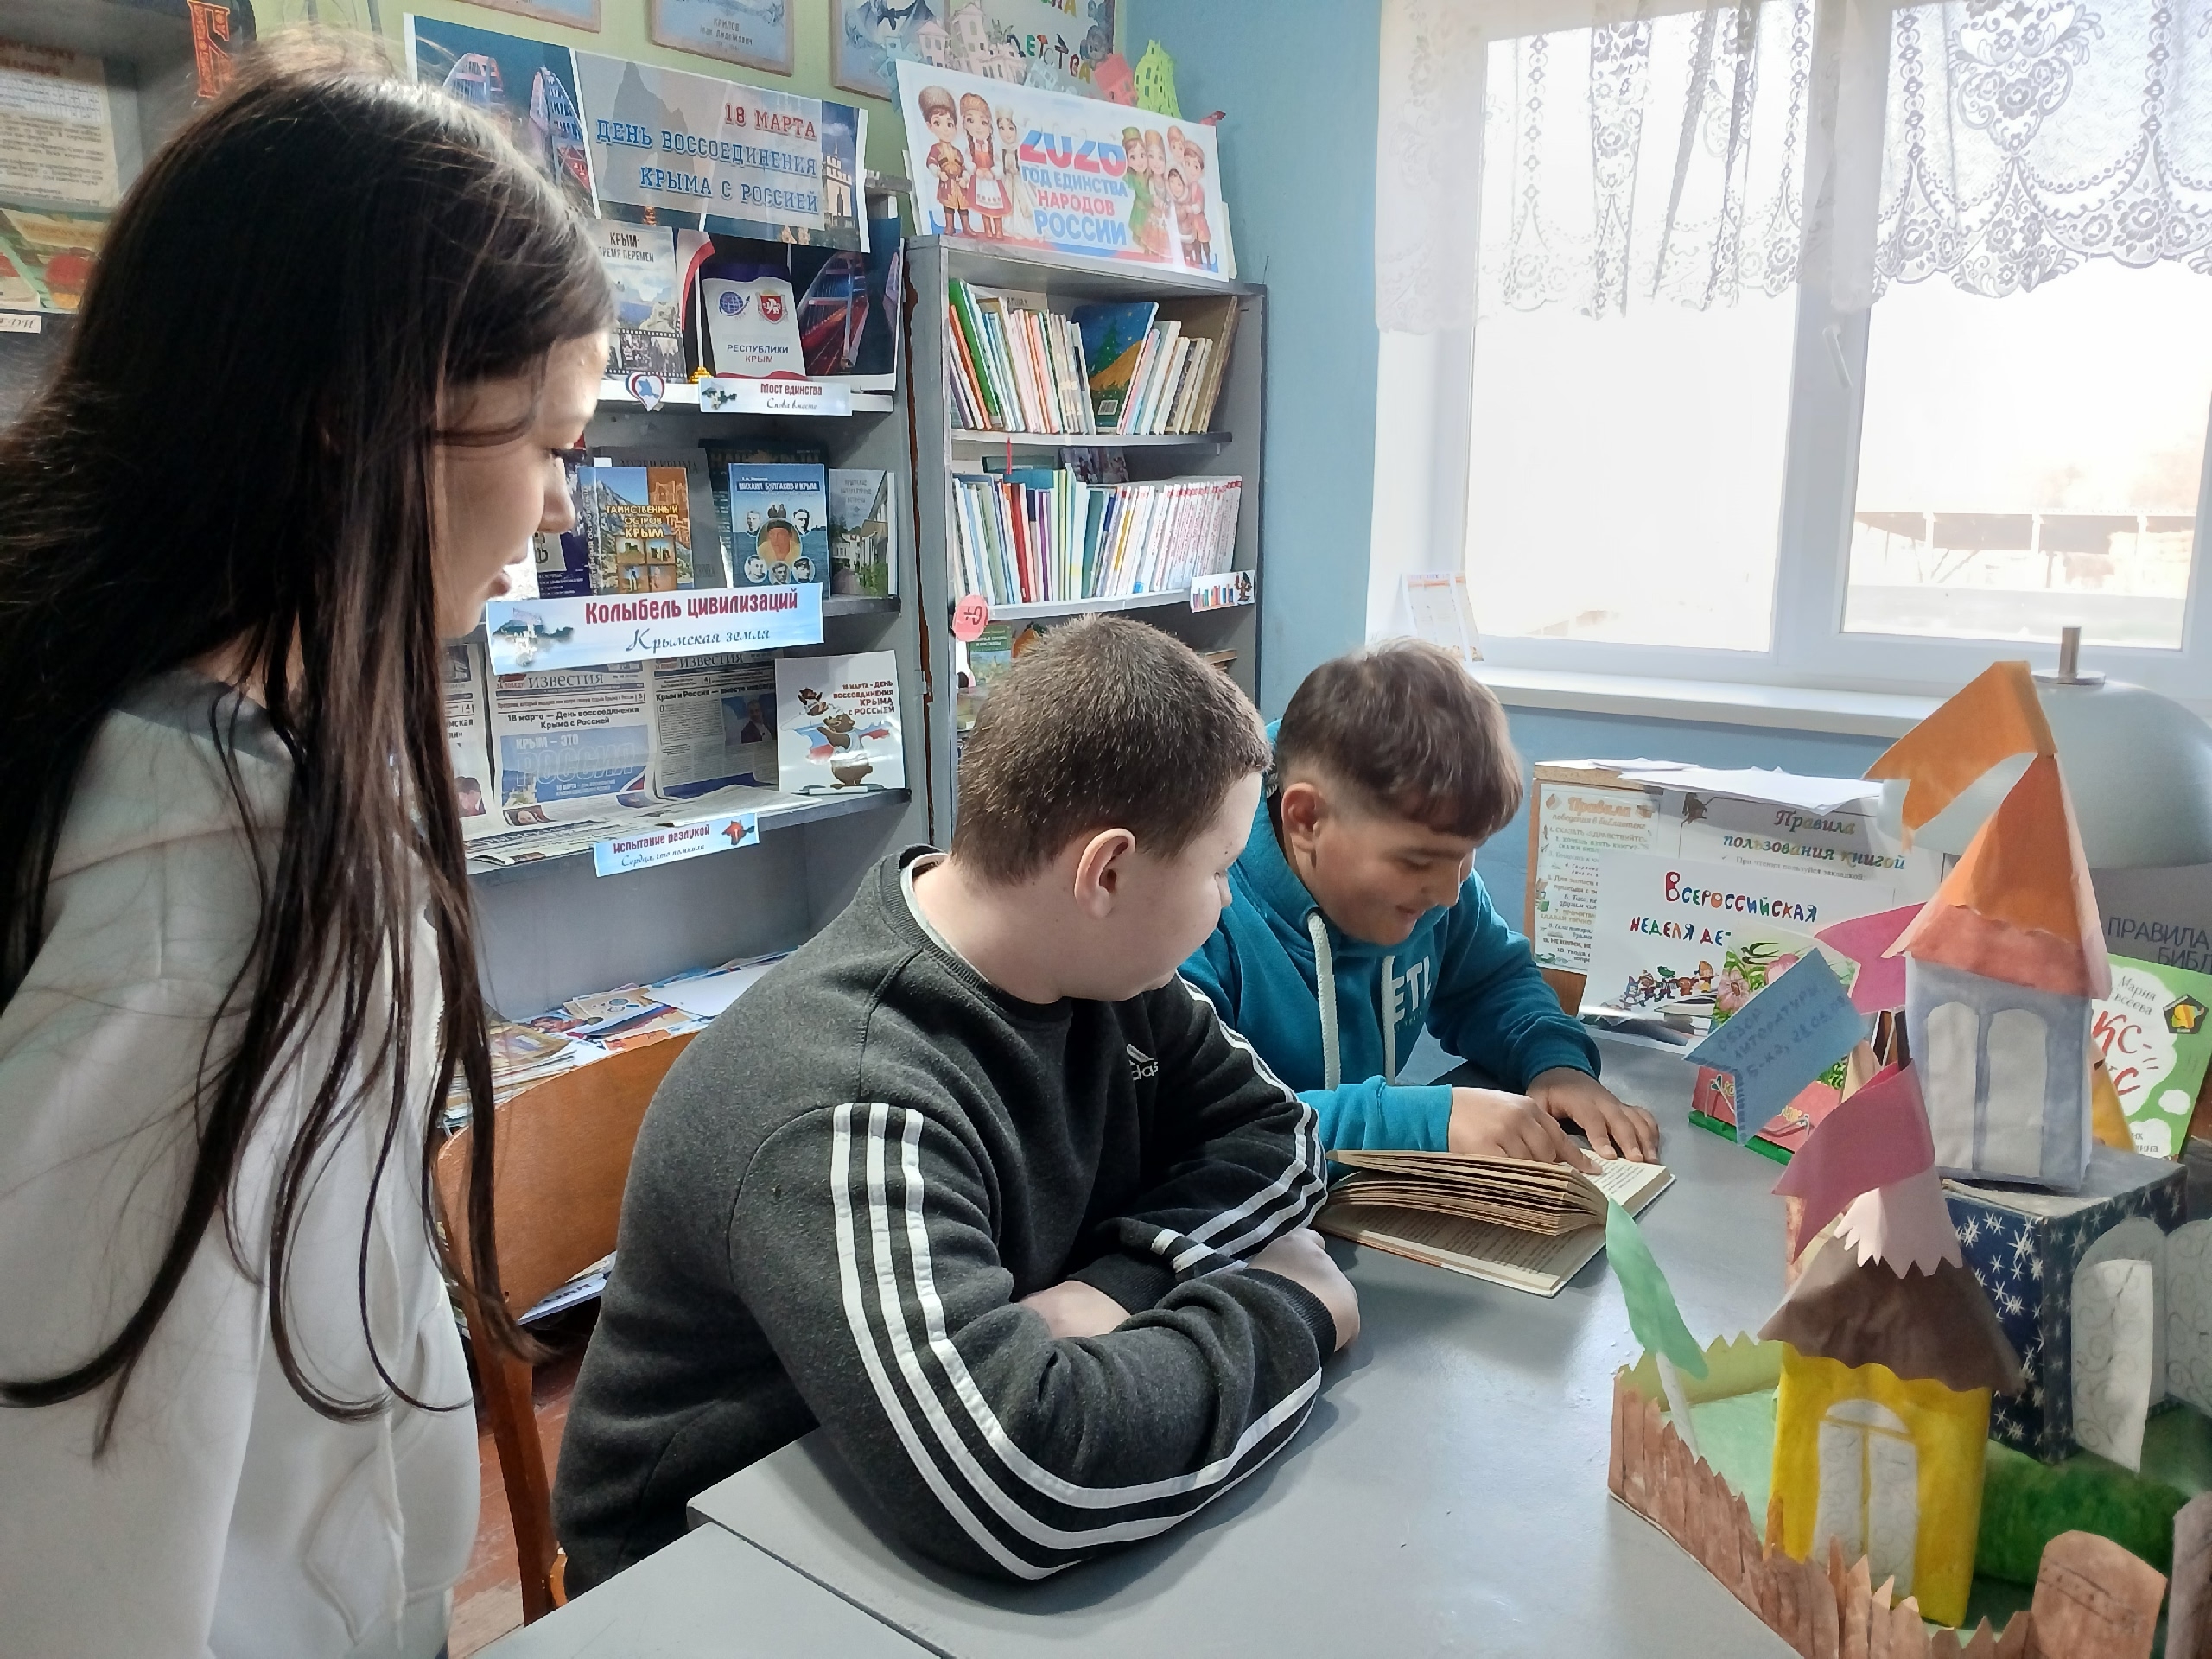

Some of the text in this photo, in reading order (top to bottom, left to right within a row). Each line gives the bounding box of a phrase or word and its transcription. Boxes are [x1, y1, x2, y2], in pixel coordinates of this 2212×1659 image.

[725, 102, 817, 139] 18 МАРТА
[596, 119, 818, 176] ДЕНЬ ВОССОЕДИНЕНИЯ
[640, 167, 713, 197] КРЫМА
[741, 183, 819, 213] РОССИЕЙ
[1021, 165, 1128, 197] ГОД ЕДИНСТВА
[1037, 190, 1116, 216] НАРОДОВ
[609, 232, 640, 248] КРЫМ:
[1034, 209, 1127, 245] РОССИИ
[623, 250, 655, 263] ПЕРЕМЕН
[727, 344, 789, 353] РЕСПУБЛИКИ
[785, 385, 823, 396] единства
[606, 504, 678, 514] ТАИНСТВЕННЫЙ
[624, 516, 663, 525] ОСТРОВ
[625, 527, 664, 538] КРЫМ
[585, 588, 798, 624] Колыбель цивилизаций
[625, 628, 771, 654] Крымская земля
[656, 693, 677, 702] Крым
[874, 680, 893, 689] ДЕНЬ
[860, 697, 893, 706] КРЫМА
[518, 713, 544, 723] марта
[556, 711, 577, 721] День
[516, 736, 548, 750] КРЫМ
[560, 734, 579, 746] ЭТО
[516, 743, 636, 787] РОССИЯ
[1773, 810, 1855, 835] Правила
[613, 824, 710, 854] Испытание разлукой
[1723, 835, 1905, 870] пользования книгой
[1736, 855, 1752, 865] При
[1630, 916, 1732, 947] НЕДЕЛЯ ДЕ
[2108, 917, 2209, 950] ПРАВИЛА
[2158, 946, 2212, 975] БИБЛ
[2118, 975, 2157, 1001] Мария
[2110, 987, 2152, 1016] Евсеева
